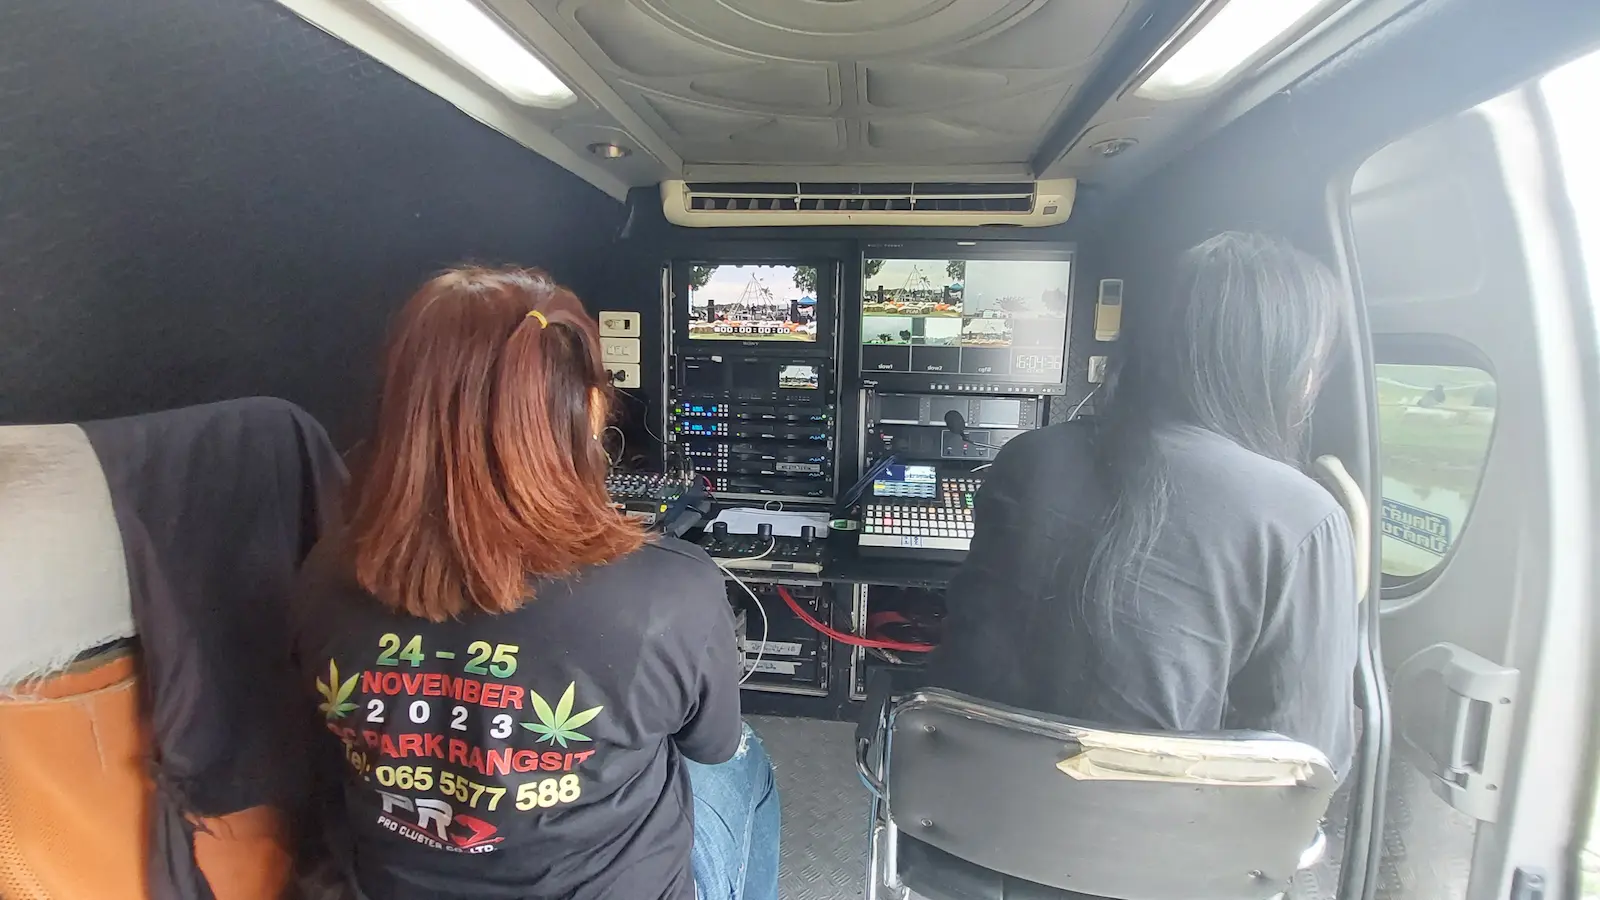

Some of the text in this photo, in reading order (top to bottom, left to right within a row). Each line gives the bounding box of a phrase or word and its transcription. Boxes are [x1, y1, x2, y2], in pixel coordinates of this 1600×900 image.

[1015, 354, 1061, 370] 16:04:36
[376, 633, 425, 667] 24
[464, 641, 519, 678] 25
[361, 671, 524, 709] NOVEMBER
[362, 730, 445, 759] PARK
[449, 738, 596, 776] RANGSIT
[375, 766, 434, 791] 065
[439, 773, 507, 811] 5577
[515, 774, 581, 811] 588
[377, 815, 398, 832] PRO
[399, 826, 443, 850] CLUSTER
